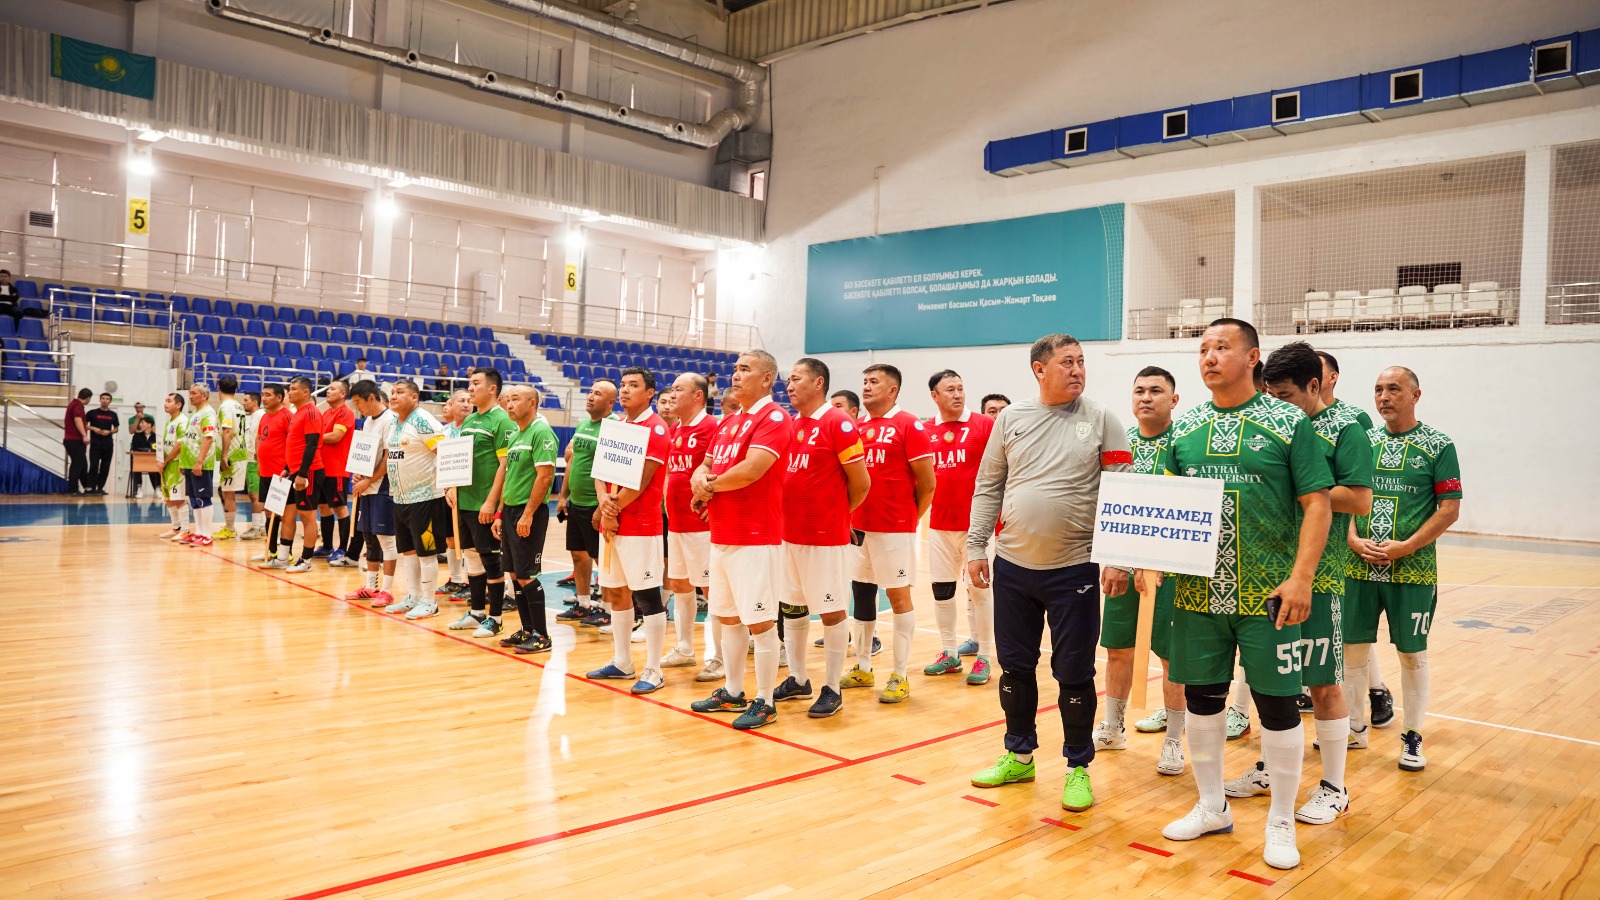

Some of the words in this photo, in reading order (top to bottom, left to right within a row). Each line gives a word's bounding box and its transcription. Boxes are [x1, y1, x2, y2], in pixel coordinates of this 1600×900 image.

[133, 209, 145, 230] 5
[567, 272, 576, 288] 6
[923, 271, 959, 281] БОЛУЫМЫЗ
[981, 279, 991, 289] ДА
[992, 276, 1024, 287] ЖАРҚЫН
[1025, 273, 1058, 284] БОЛАДЫ.
[739, 420, 753, 437] 9
[808, 427, 819, 445] 2
[876, 426, 896, 444] 12
[960, 427, 970, 443] 7
[687, 433, 697, 448] 6
[603, 452, 633, 466] АУДАНЫ
[1200, 465, 1240, 474] ATYRAU
[1373, 483, 1419, 494] NIVERSITY
[1101, 503, 1213, 526] ДОСМҰХАМЕД
[1100, 521, 1212, 543] УНИВЕРСИТЕТ
[1411, 612, 1430, 636] 70
[1277, 640, 1302, 675] 55
[1300, 637, 1330, 667] 77
